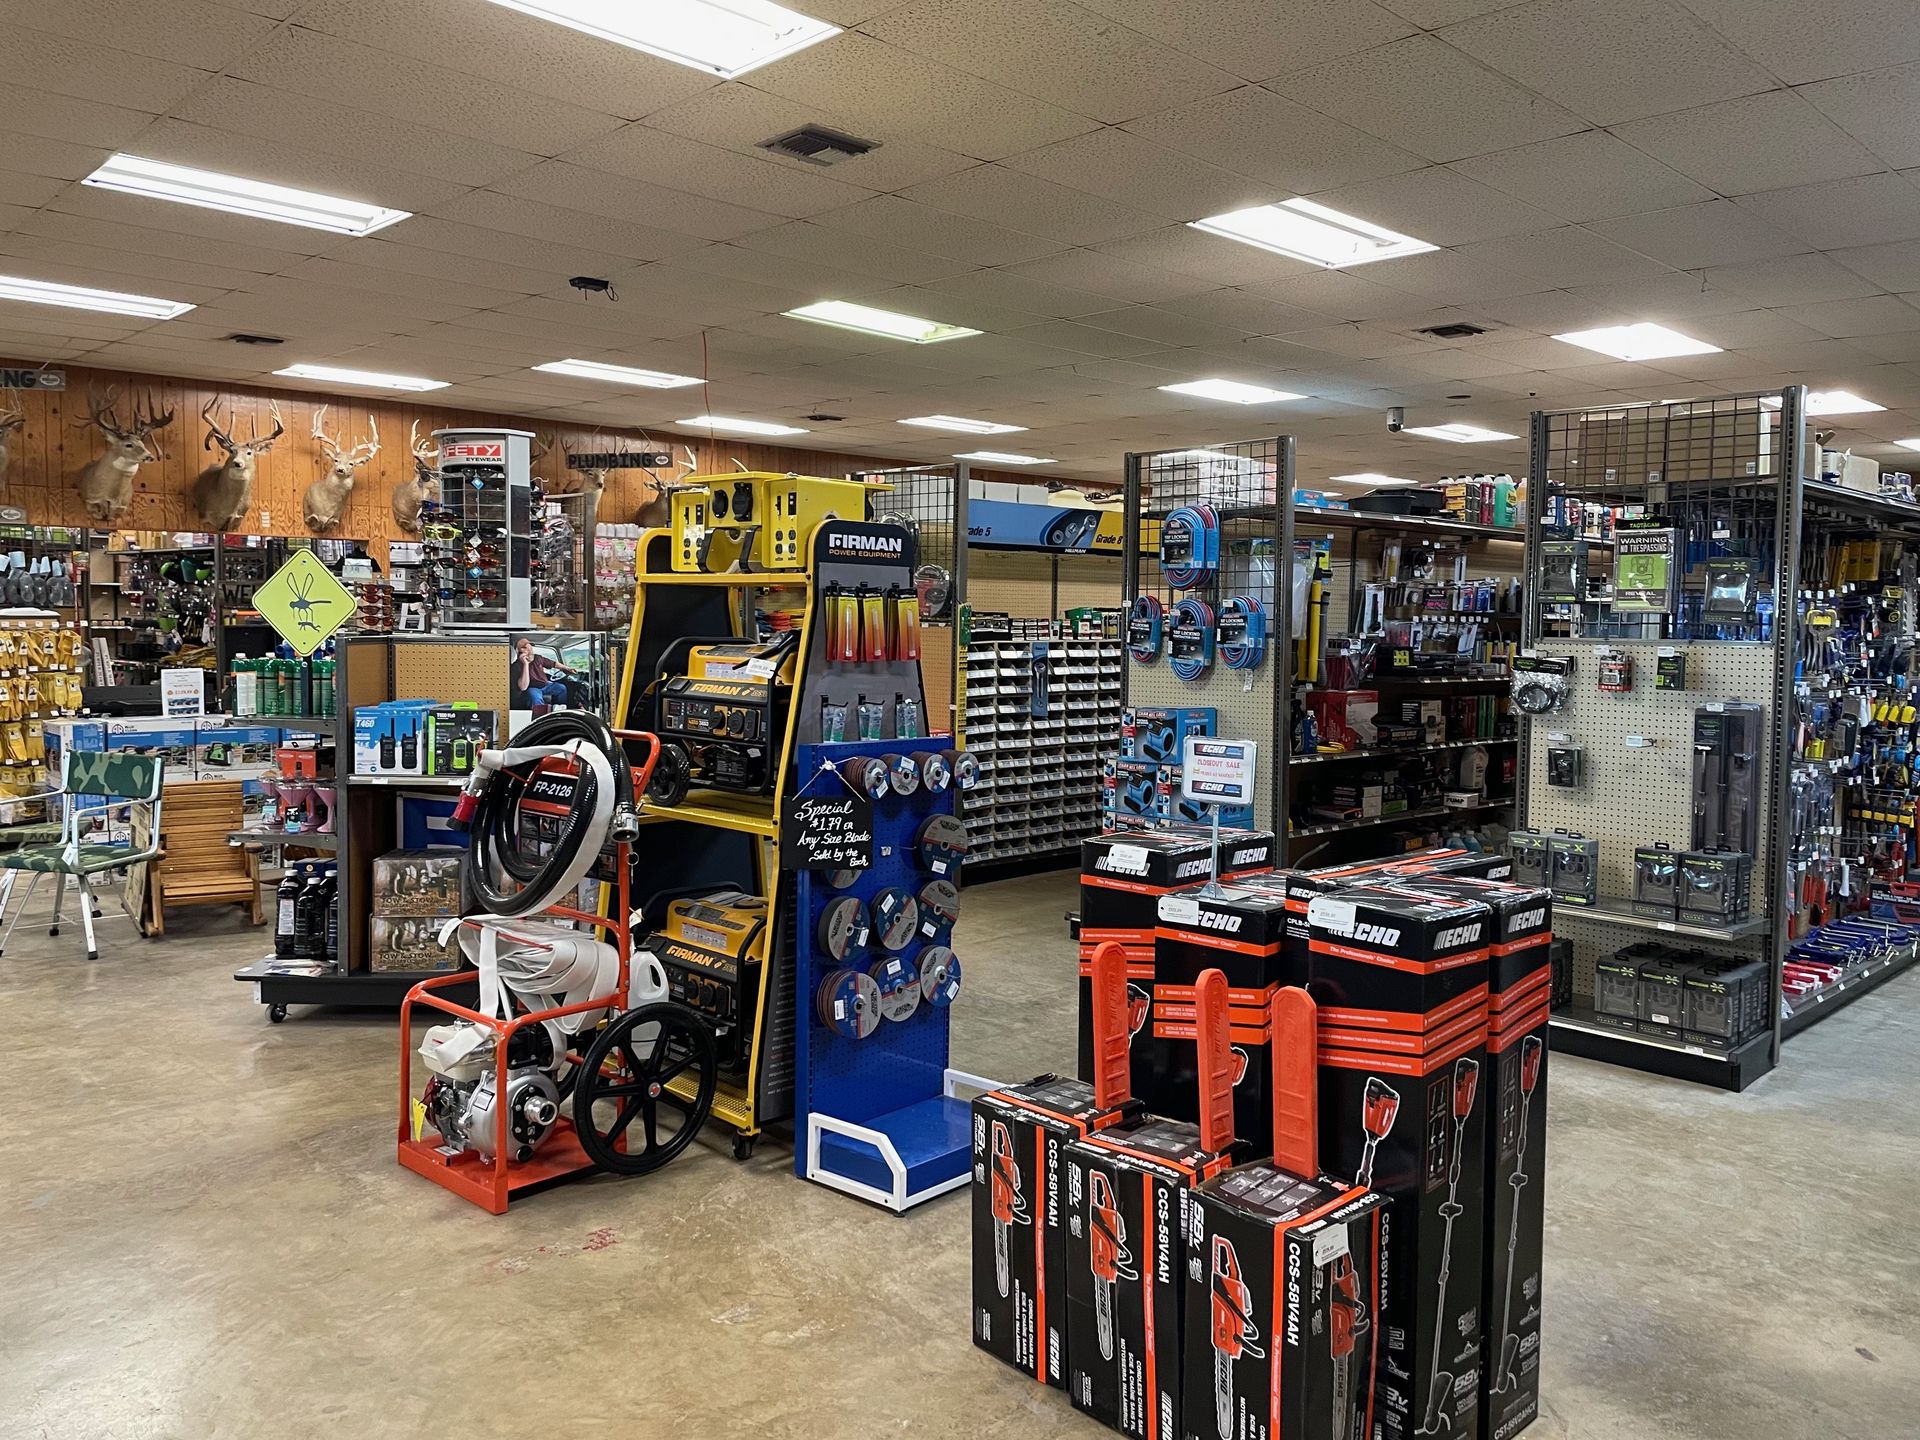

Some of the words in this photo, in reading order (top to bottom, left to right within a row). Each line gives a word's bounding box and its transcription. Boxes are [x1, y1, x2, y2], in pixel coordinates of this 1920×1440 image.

[0, 370, 36, 388] NG
[444, 445, 498, 456] FETY
[568, 453, 651, 468] PLUMBING
[968, 526, 983, 536] rade
[985, 527, 991, 537] 5
[1096, 534, 1116, 544] Grade
[1117, 536, 1123, 544] 8
[829, 534, 902, 552] FIRMAN
[1630, 544, 1667, 552] TRESPASSING
[858, 551, 901, 559] EQUIPMENT
[690, 684, 740, 696] FIRMAN
[356, 720, 375, 728] T460
[1202, 745, 1227, 754] ECHO
[1197, 759, 1223, 767] CLOSEOUT
[533, 781, 573, 797] FP-2126
[1200, 783, 1224, 791] ECHO
[794, 800, 853, 821] Special
[810, 817, 842, 831] $1.79
[797, 831, 820, 850] Any
[821, 833, 842, 844] Size
[844, 831, 871, 843] Blade
[808, 849, 832, 862] Sold
[834, 848, 843, 861] by
[845, 848, 858, 856] the
[850, 855, 869, 866] Each
[1241, 847, 1267, 863] ECHO
[1184, 858, 1212, 878] ECHO
[1493, 865, 1511, 878] ECHO
[1197, 911, 1242, 932] CHO
[1517, 908, 1545, 931] ECHO
[1444, 923, 1482, 949] ECHO
[666, 945, 714, 967] FIRMAN
[1340, 947, 1376, 960] Professionals'
[1376, 955, 1398, 964] Choice
[976, 1114, 986, 1157] 58V
[1049, 1139, 1058, 1227] CCS-58V4AH
[1072, 1163, 1082, 1208] 58V
[1158, 1187, 1170, 1284] CCS-58V4AH
[1194, 1202, 1205, 1251] 58V
[1381, 1213, 1389, 1311] CCS-58V4AH
[1315, 1265, 1323, 1300] 8V
[1287, 1242, 1300, 1346] CCS-58V4AH
[1050, 1340, 1060, 1379] ECHO
[1220, 1361, 1228, 1397] ECHO
